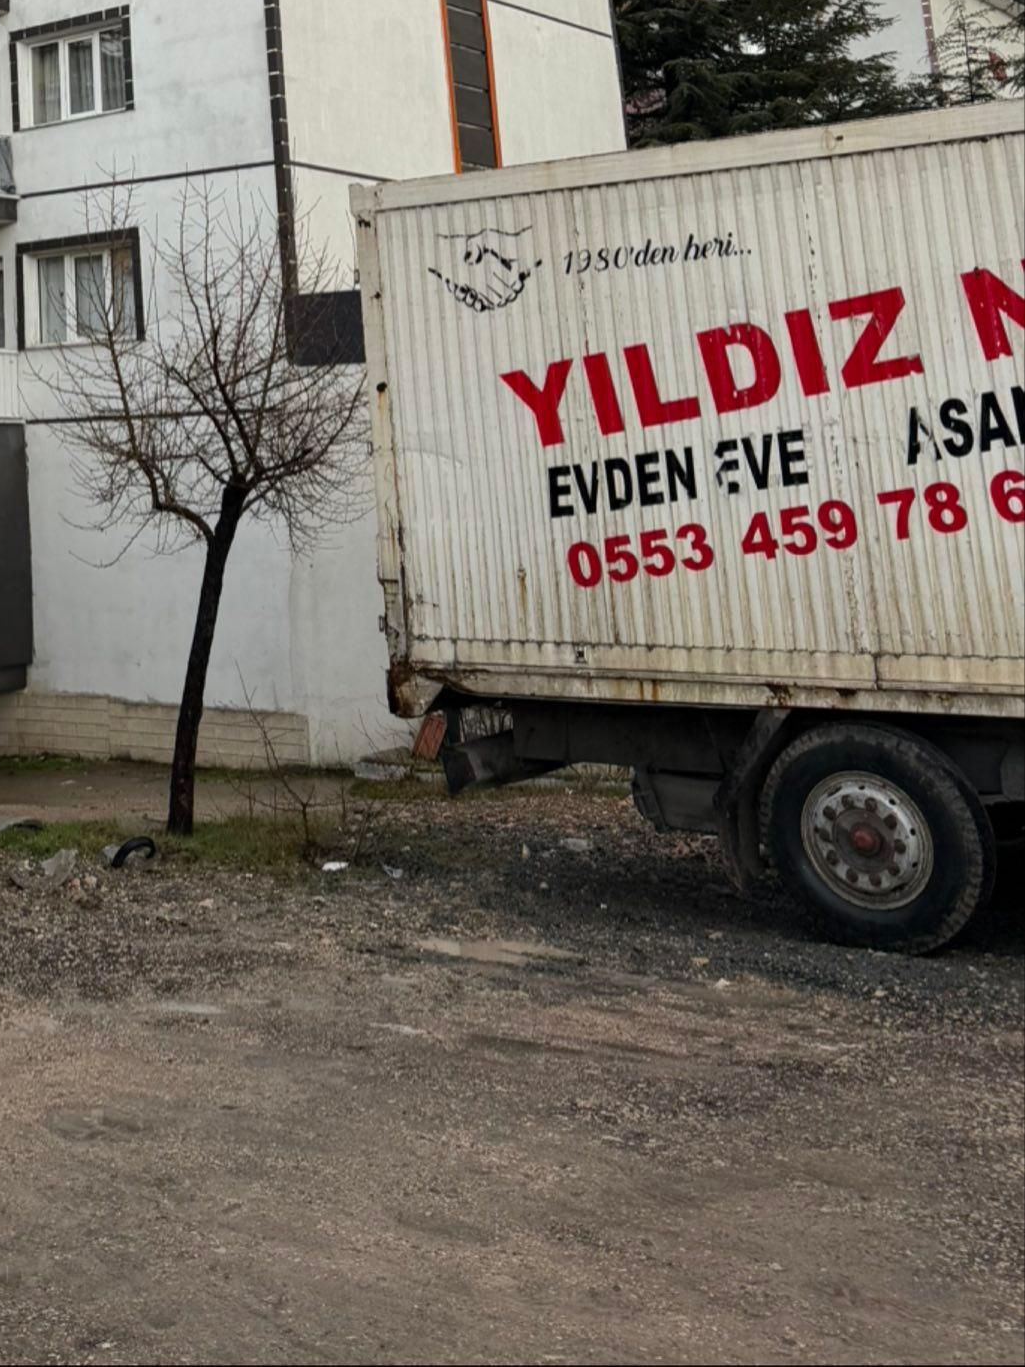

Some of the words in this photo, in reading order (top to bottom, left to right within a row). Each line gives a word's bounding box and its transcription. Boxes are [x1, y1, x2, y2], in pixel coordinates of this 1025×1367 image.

[500, 287, 925, 448] YILDIZ
[548, 446, 698, 518] EVDEN
[714, 429, 810, 495] EVE
[567, 522, 714, 588] 0553
[741, 499, 858, 560] 459
[877, 482, 968, 540] 78
